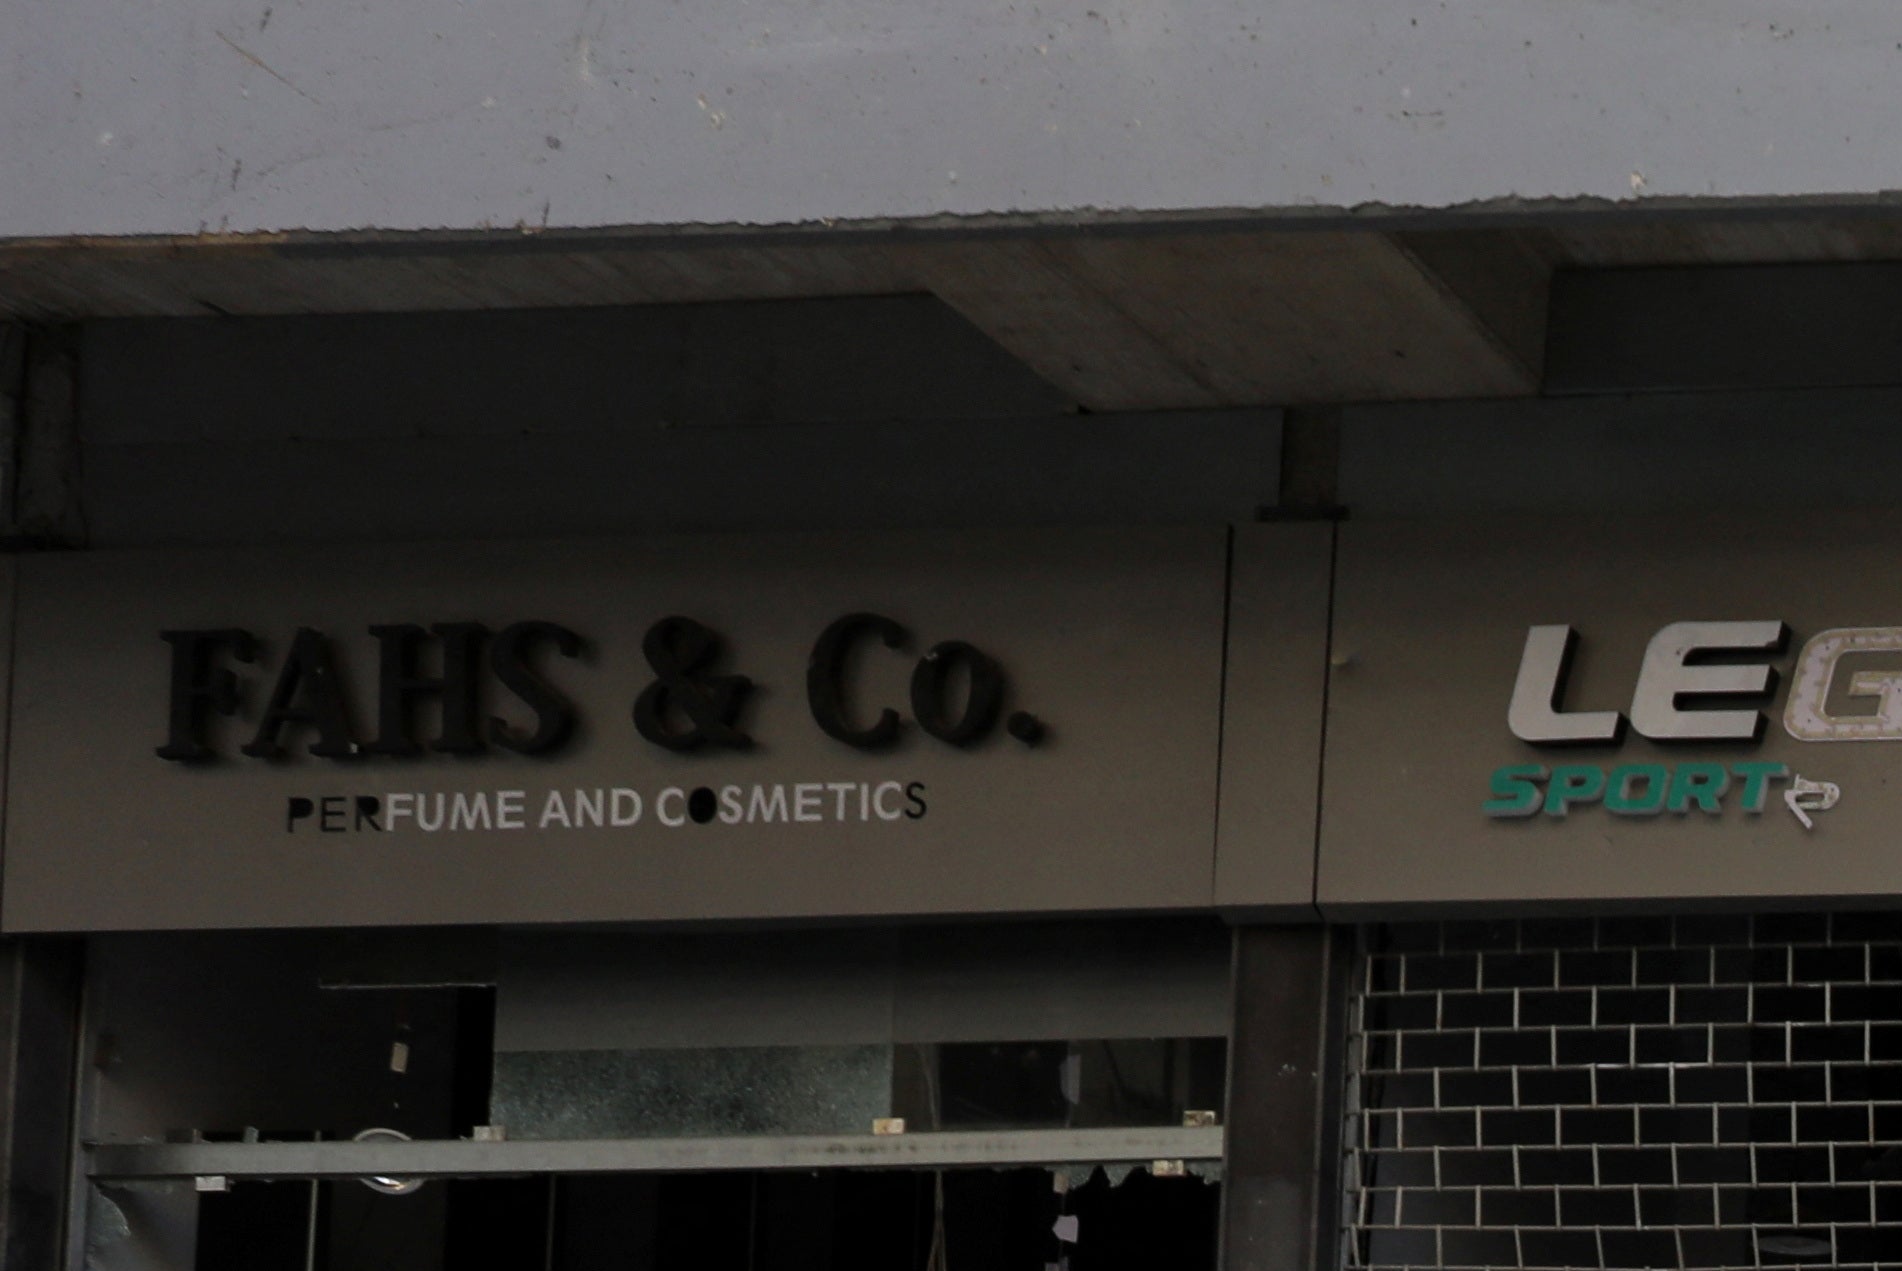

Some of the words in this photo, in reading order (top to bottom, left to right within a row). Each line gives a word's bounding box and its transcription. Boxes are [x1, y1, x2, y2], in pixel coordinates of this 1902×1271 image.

[155, 618, 585, 759] FAHS
[633, 615, 754, 753] &
[804, 612, 1045, 750] Co.
[286, 790, 526, 835] PERFUME
[538, 787, 643, 829] AND
[654, 780, 928, 828] COSMETICS
